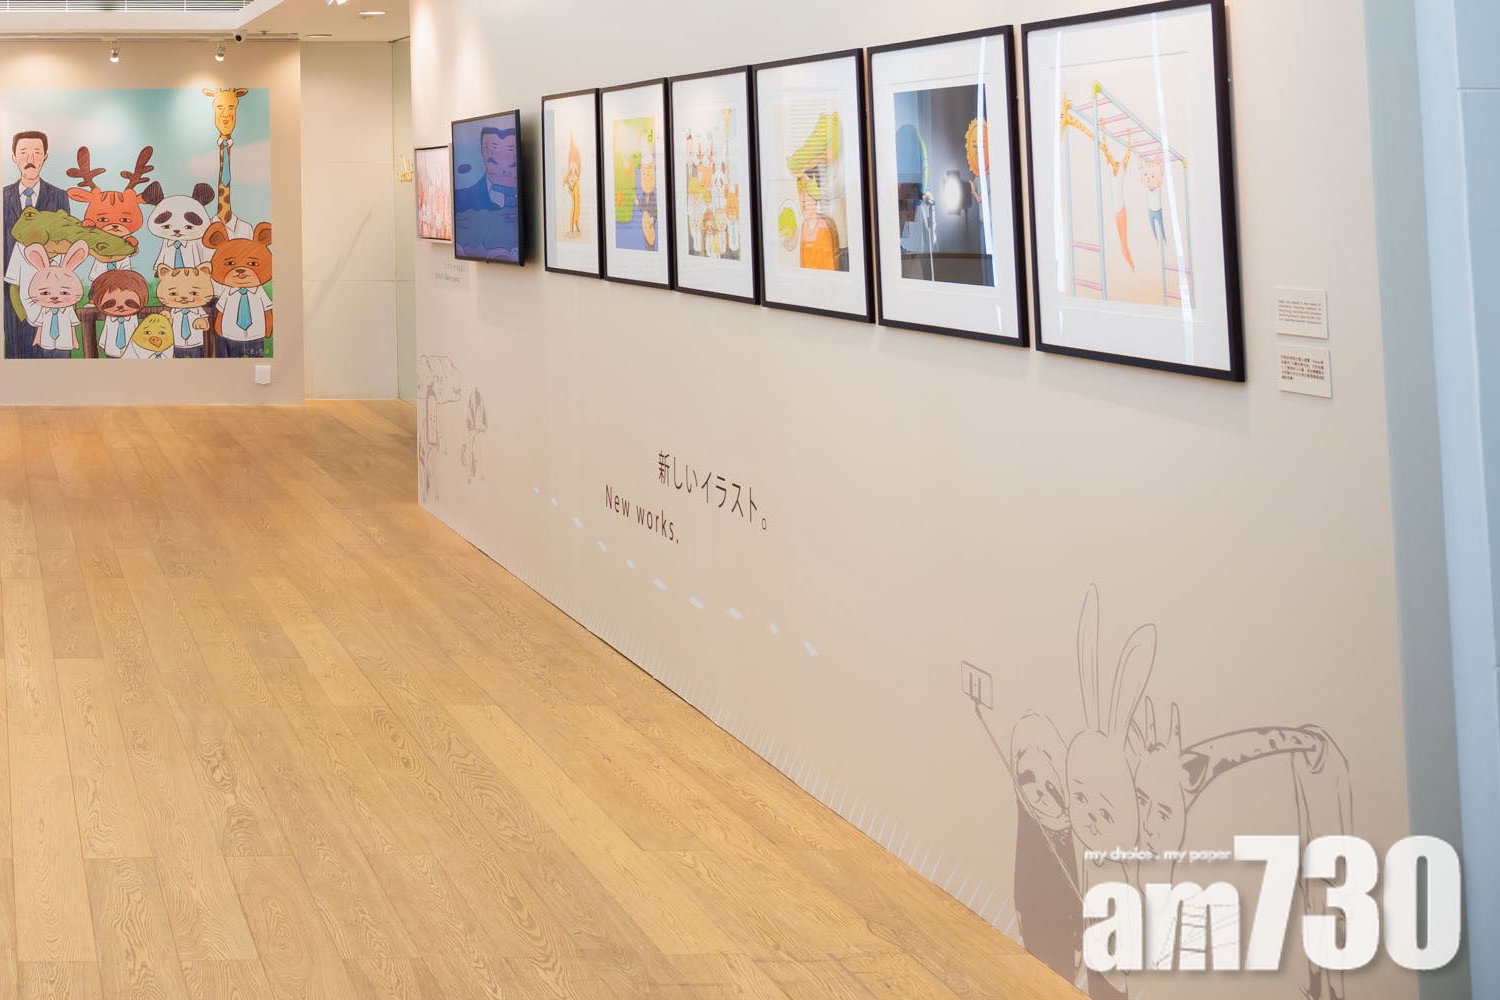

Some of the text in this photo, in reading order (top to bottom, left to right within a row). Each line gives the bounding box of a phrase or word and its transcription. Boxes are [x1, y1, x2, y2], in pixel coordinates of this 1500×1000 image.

[605, 484, 678, 543] New works.
[658, 450, 767, 531] 新しいイラスト。
